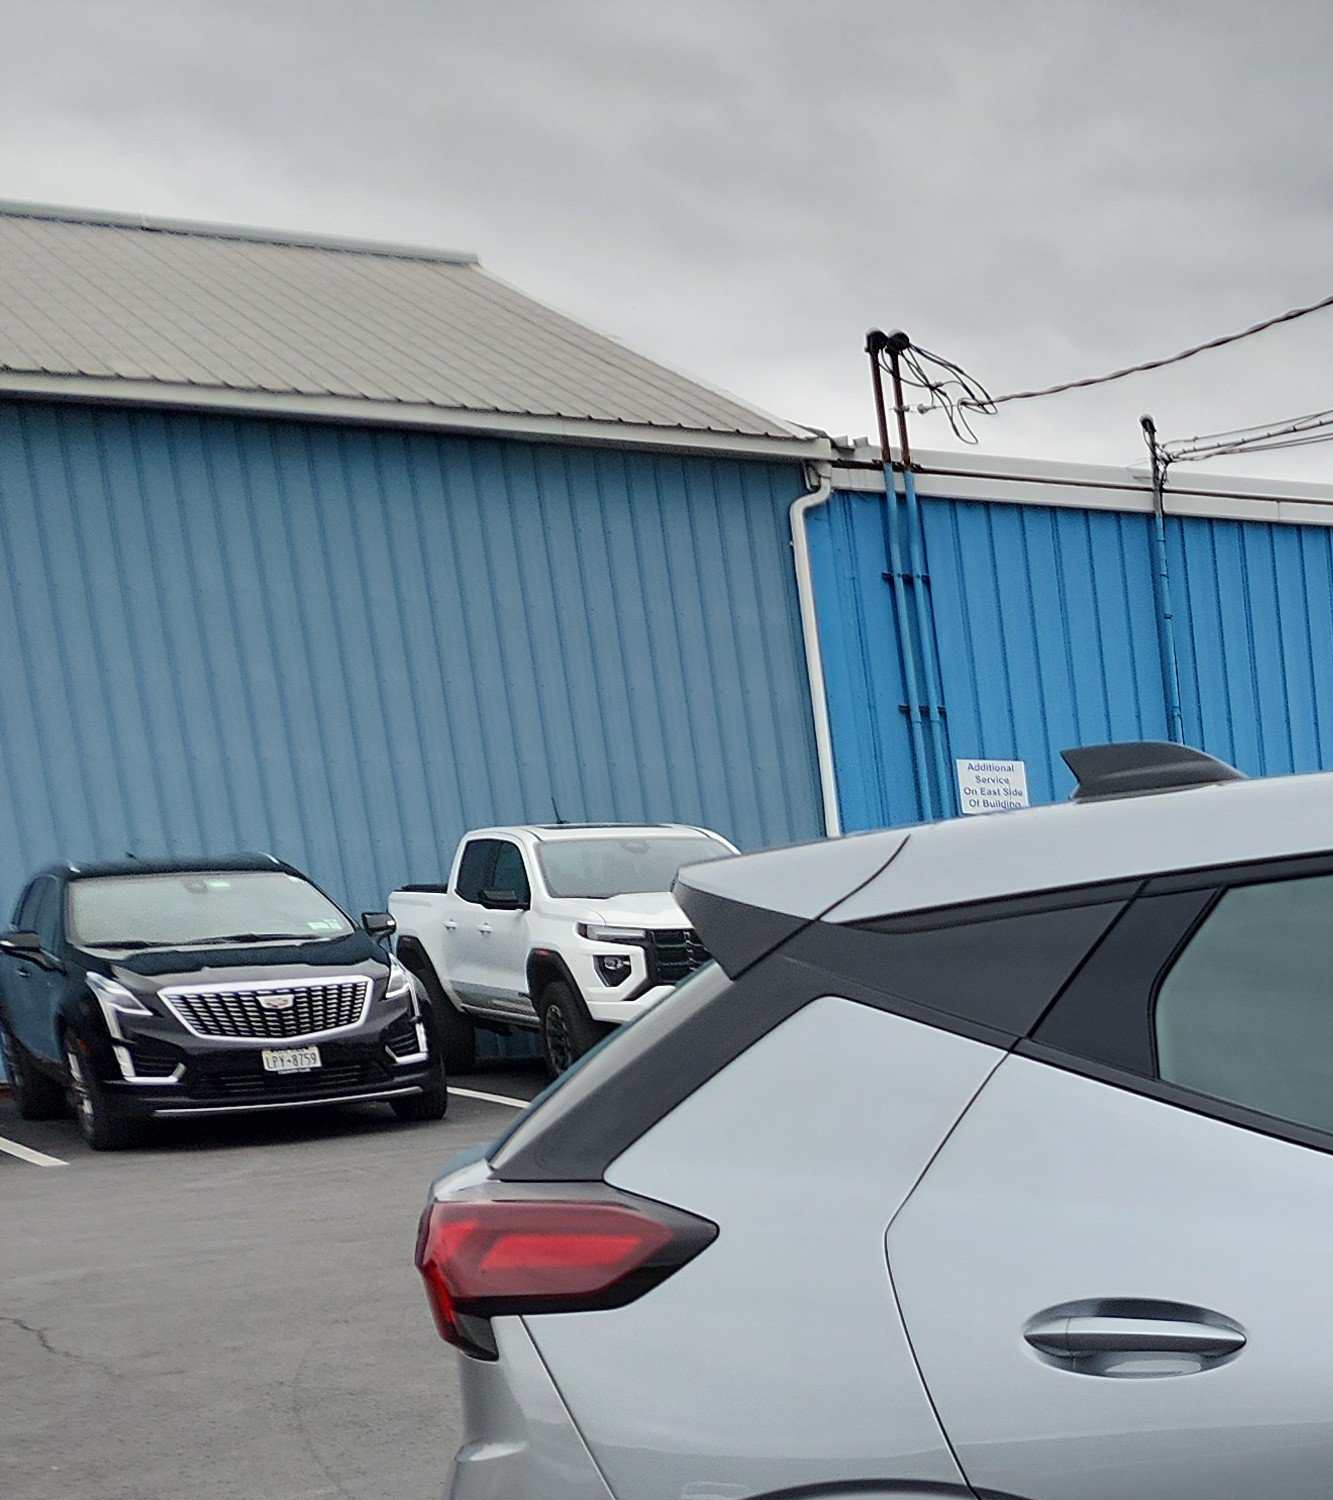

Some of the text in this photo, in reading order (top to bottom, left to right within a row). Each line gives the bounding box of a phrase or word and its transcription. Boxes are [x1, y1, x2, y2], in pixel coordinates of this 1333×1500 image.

[967, 763, 1015, 772] Additional
[975, 775, 1010, 784] Service
[963, 787, 1023, 796] On East Side
[969, 798, 980, 808] Of
